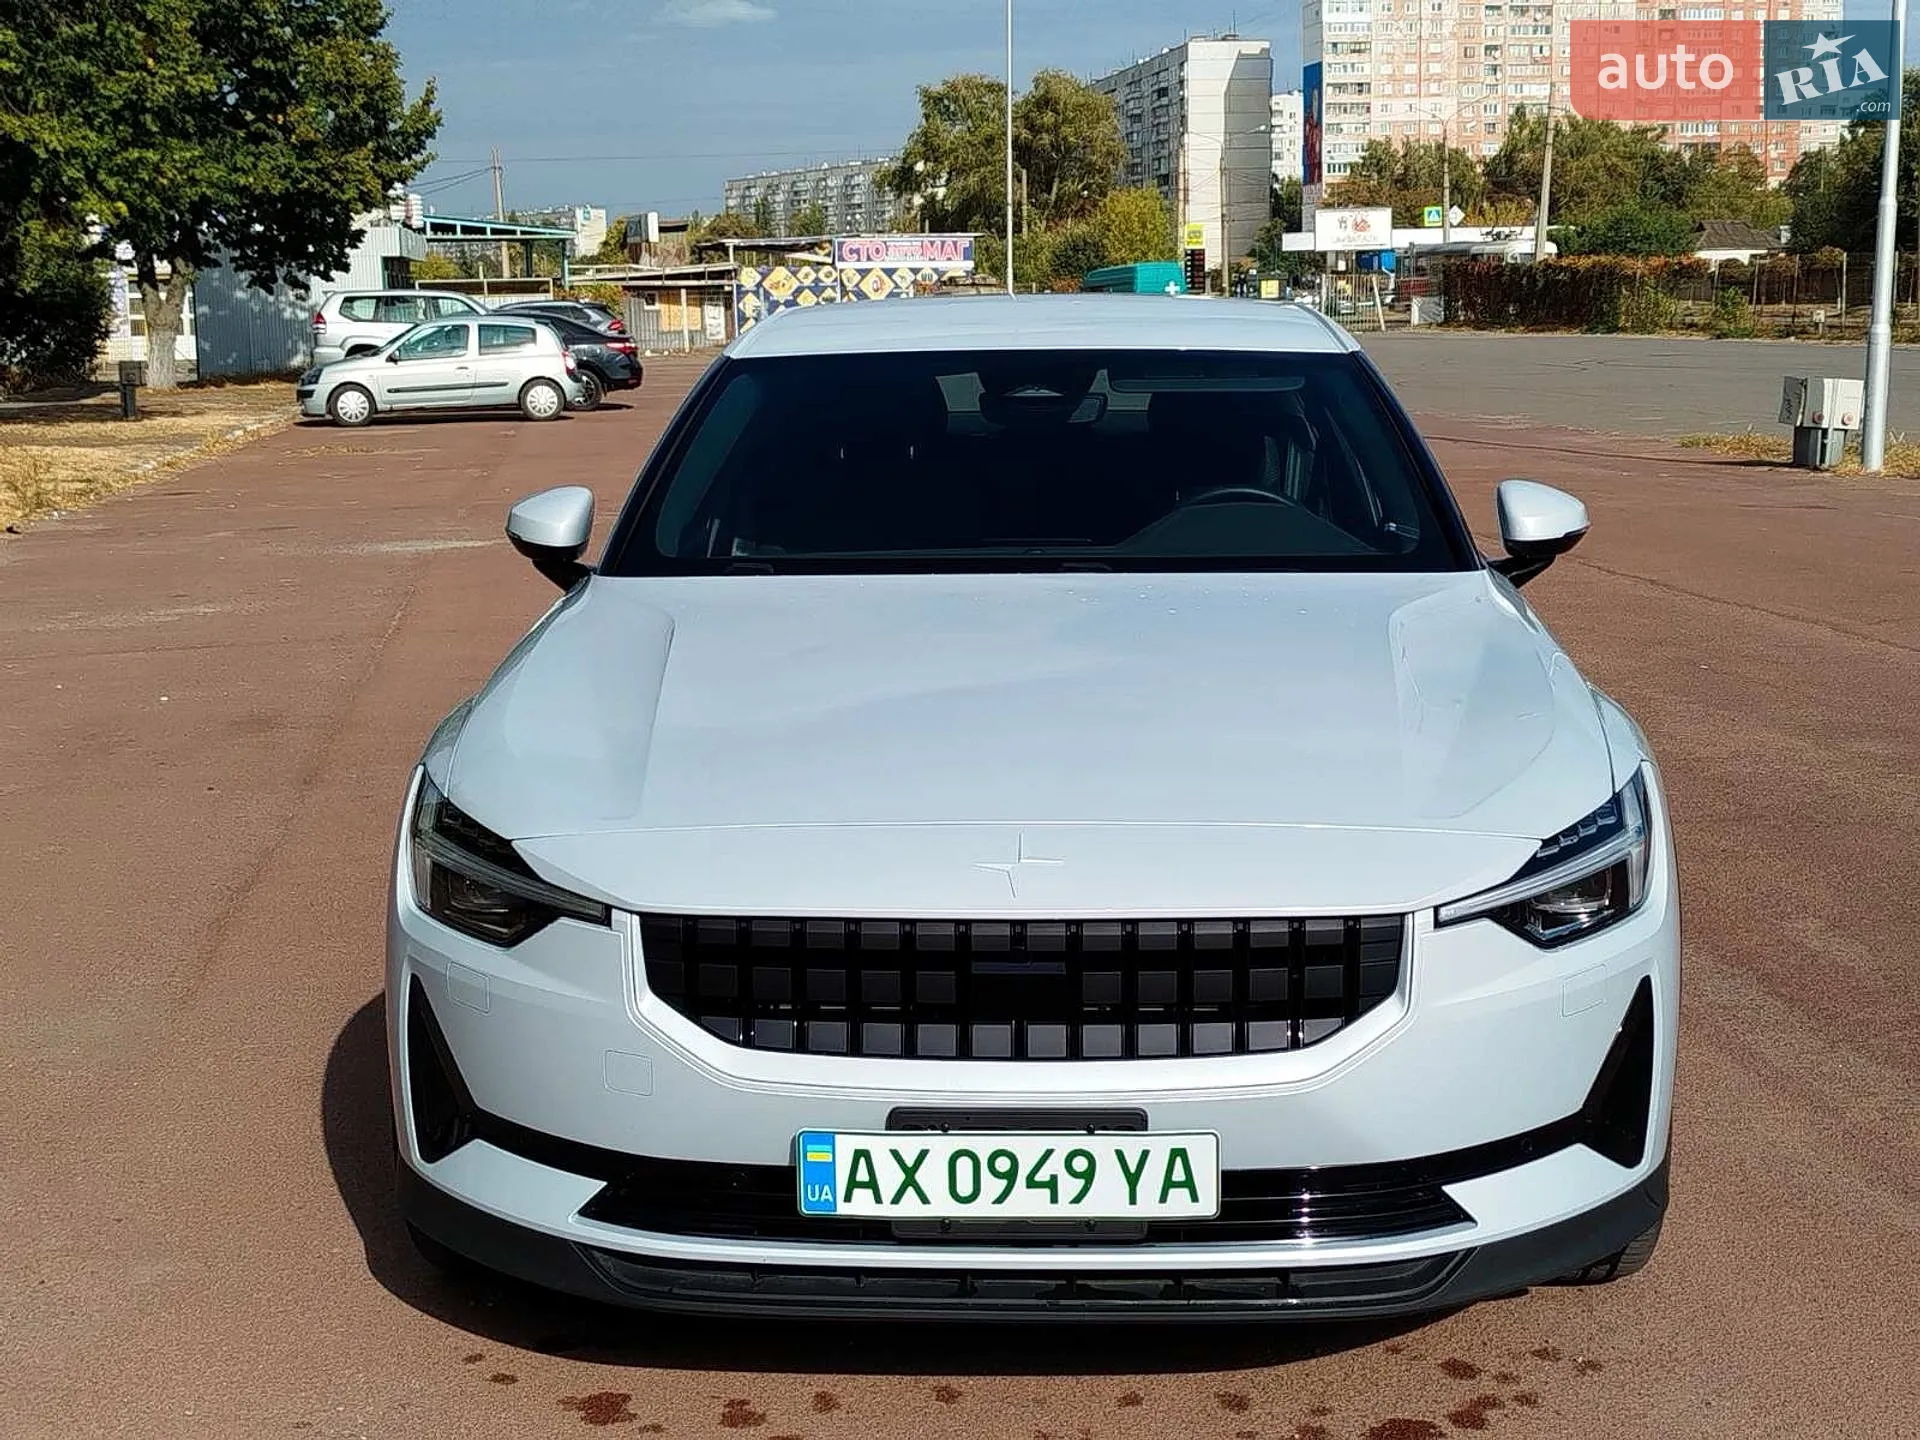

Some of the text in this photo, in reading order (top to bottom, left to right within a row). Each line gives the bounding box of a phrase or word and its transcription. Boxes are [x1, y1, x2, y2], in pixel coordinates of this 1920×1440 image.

[842, 240, 887, 262] СТО
[843, 1147, 1200, 1206] AX 0949 YA
[806, 1183, 834, 1203] UA
